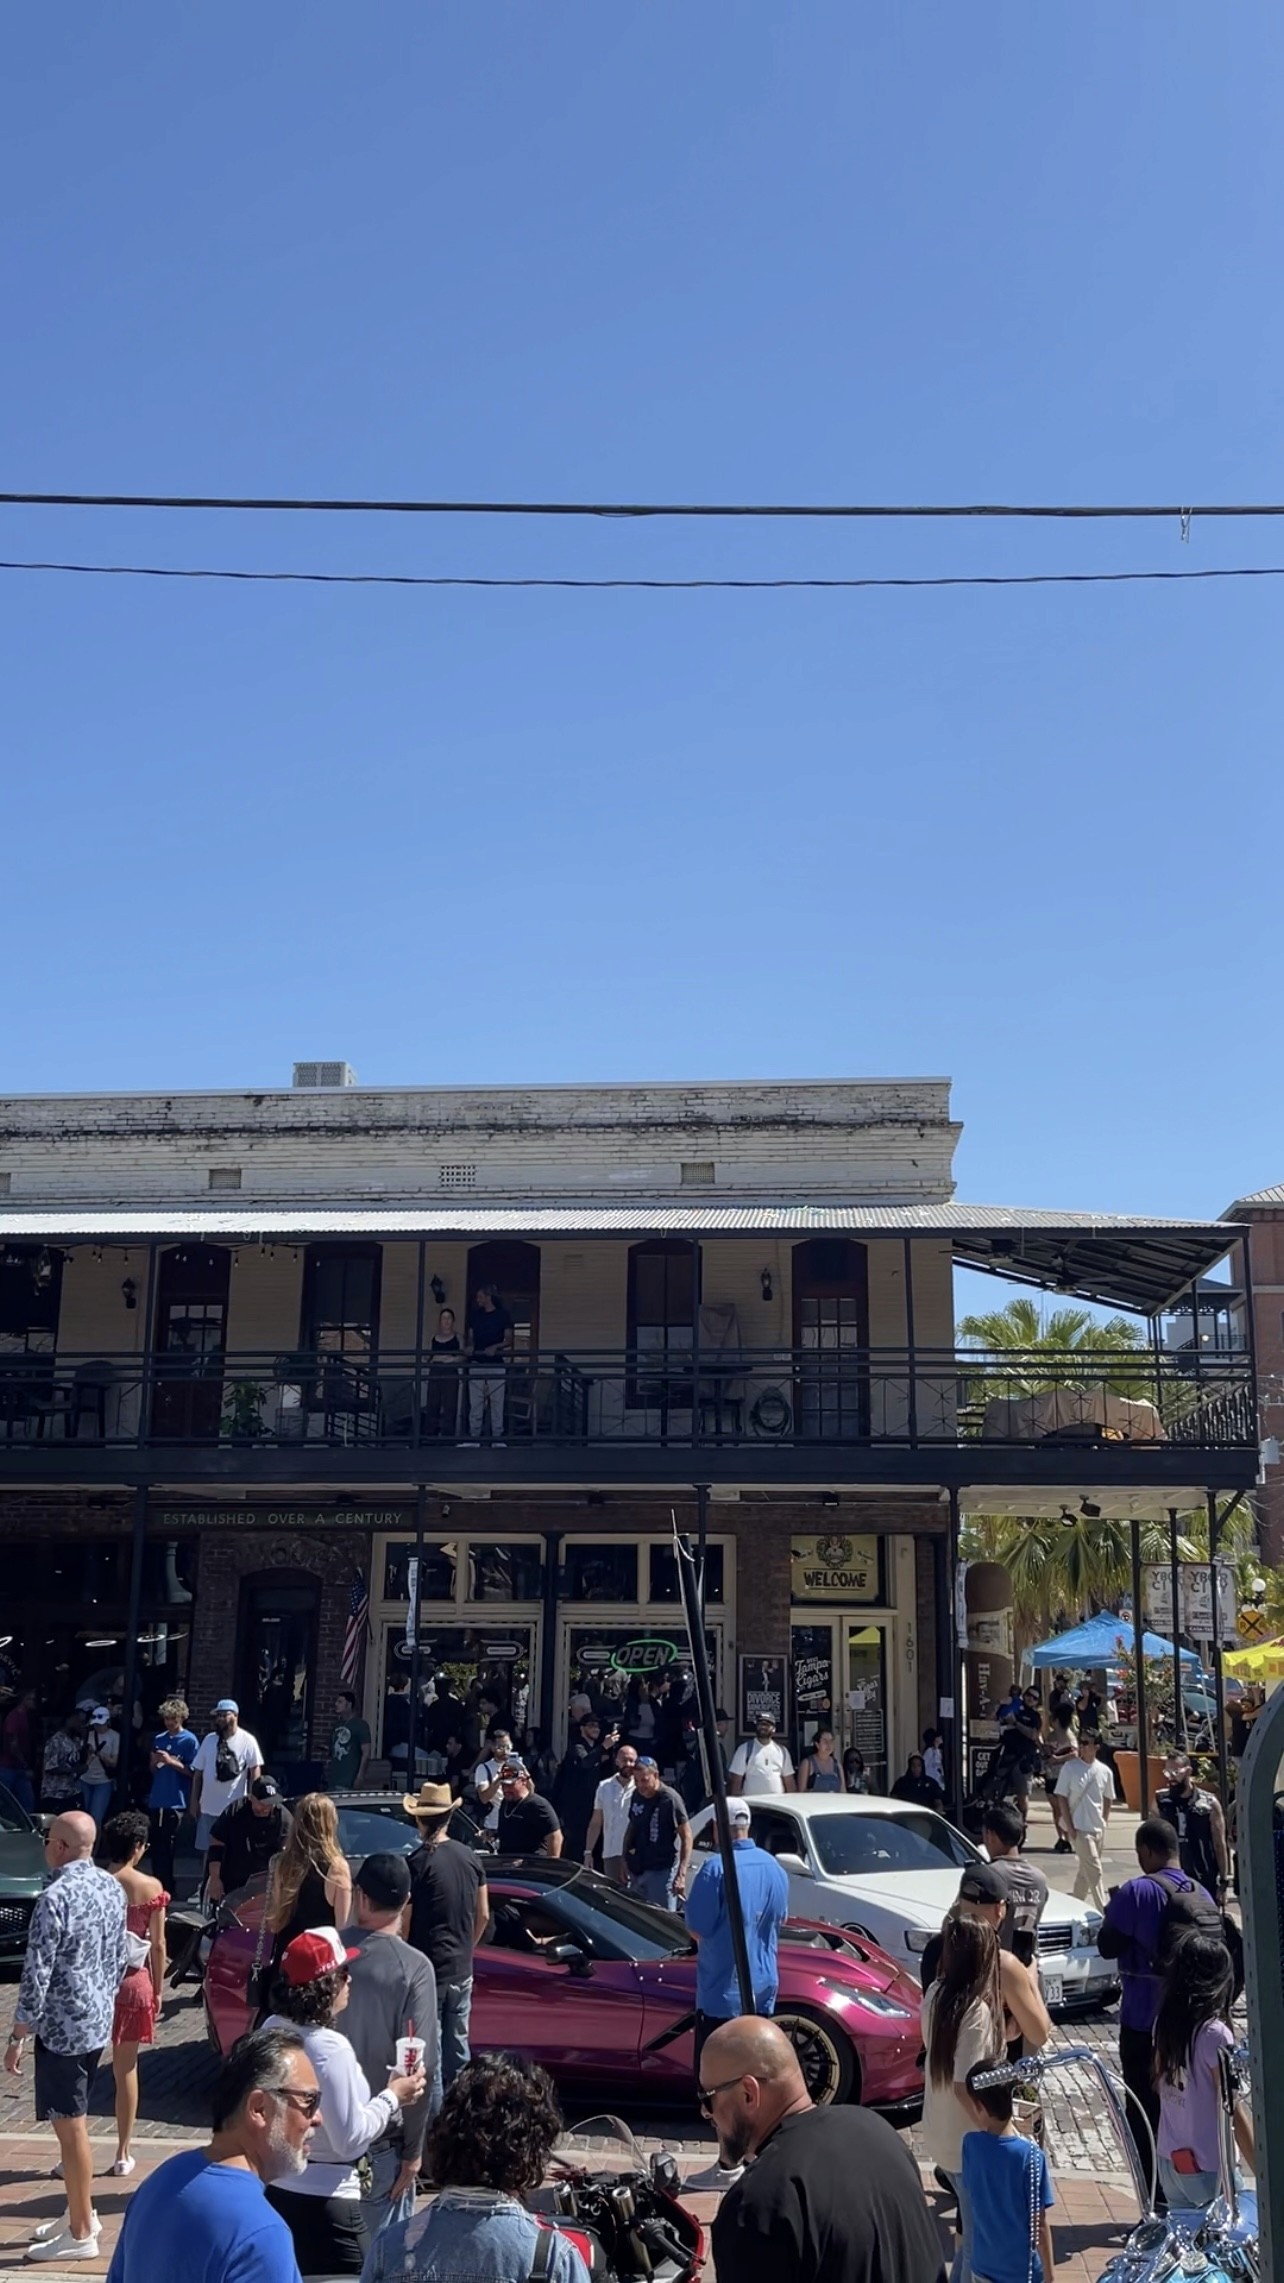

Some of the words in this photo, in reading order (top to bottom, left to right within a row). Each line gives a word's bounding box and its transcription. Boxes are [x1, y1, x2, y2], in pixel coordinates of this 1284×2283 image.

[163, 1513, 256, 1525] ESTABLISHED
[268, 1513, 305, 1524] OVER
[314, 1513, 326, 1524] A
[335, 1512, 402, 1524] CENTURY
[803, 1571, 867, 1588] WELCOME
[1190, 1581, 1228, 1593] CIY
[906, 1621, 914, 1673] 1601
[616, 1646, 670, 1665] OPEN
[794, 1659, 831, 1675] Tampa
[795, 1672, 829, 1689] Cigars
[746, 1691, 781, 1704] DIVORCE
[977, 1752, 991, 1761] GET
